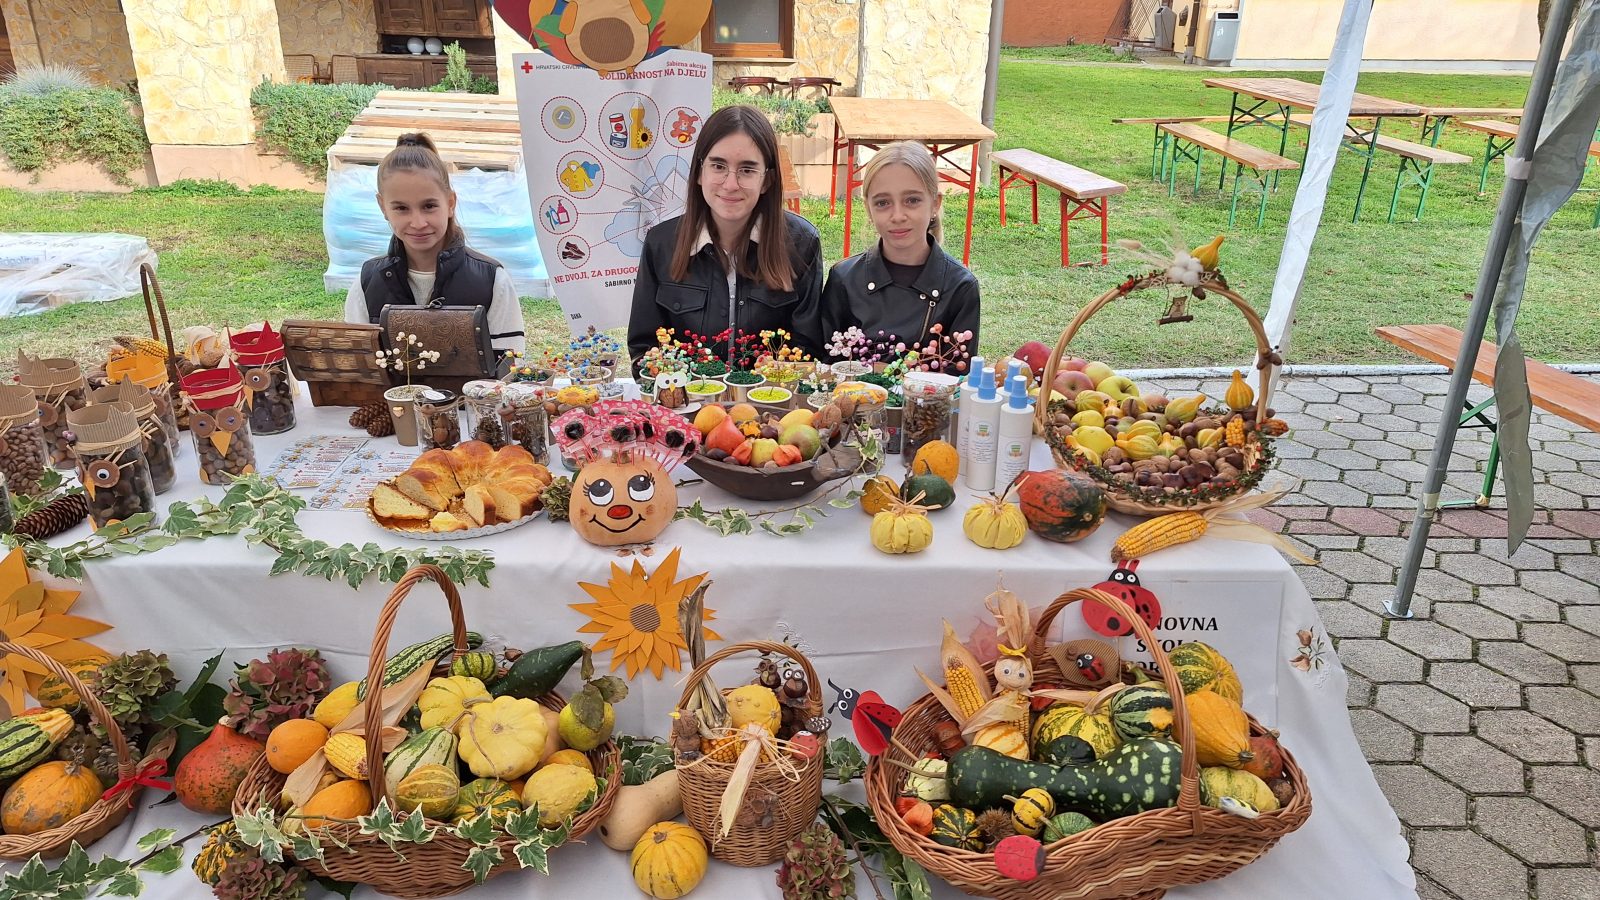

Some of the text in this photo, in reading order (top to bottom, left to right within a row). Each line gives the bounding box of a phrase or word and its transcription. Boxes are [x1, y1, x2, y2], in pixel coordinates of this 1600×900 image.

[600, 70, 662, 80] SOLIDARNOST
[678, 68, 706, 78] DJELU
[554, 275, 564, 284] NE
[565, 272, 589, 281] DVOJI,
[604, 279, 632, 287] SABIRNO
